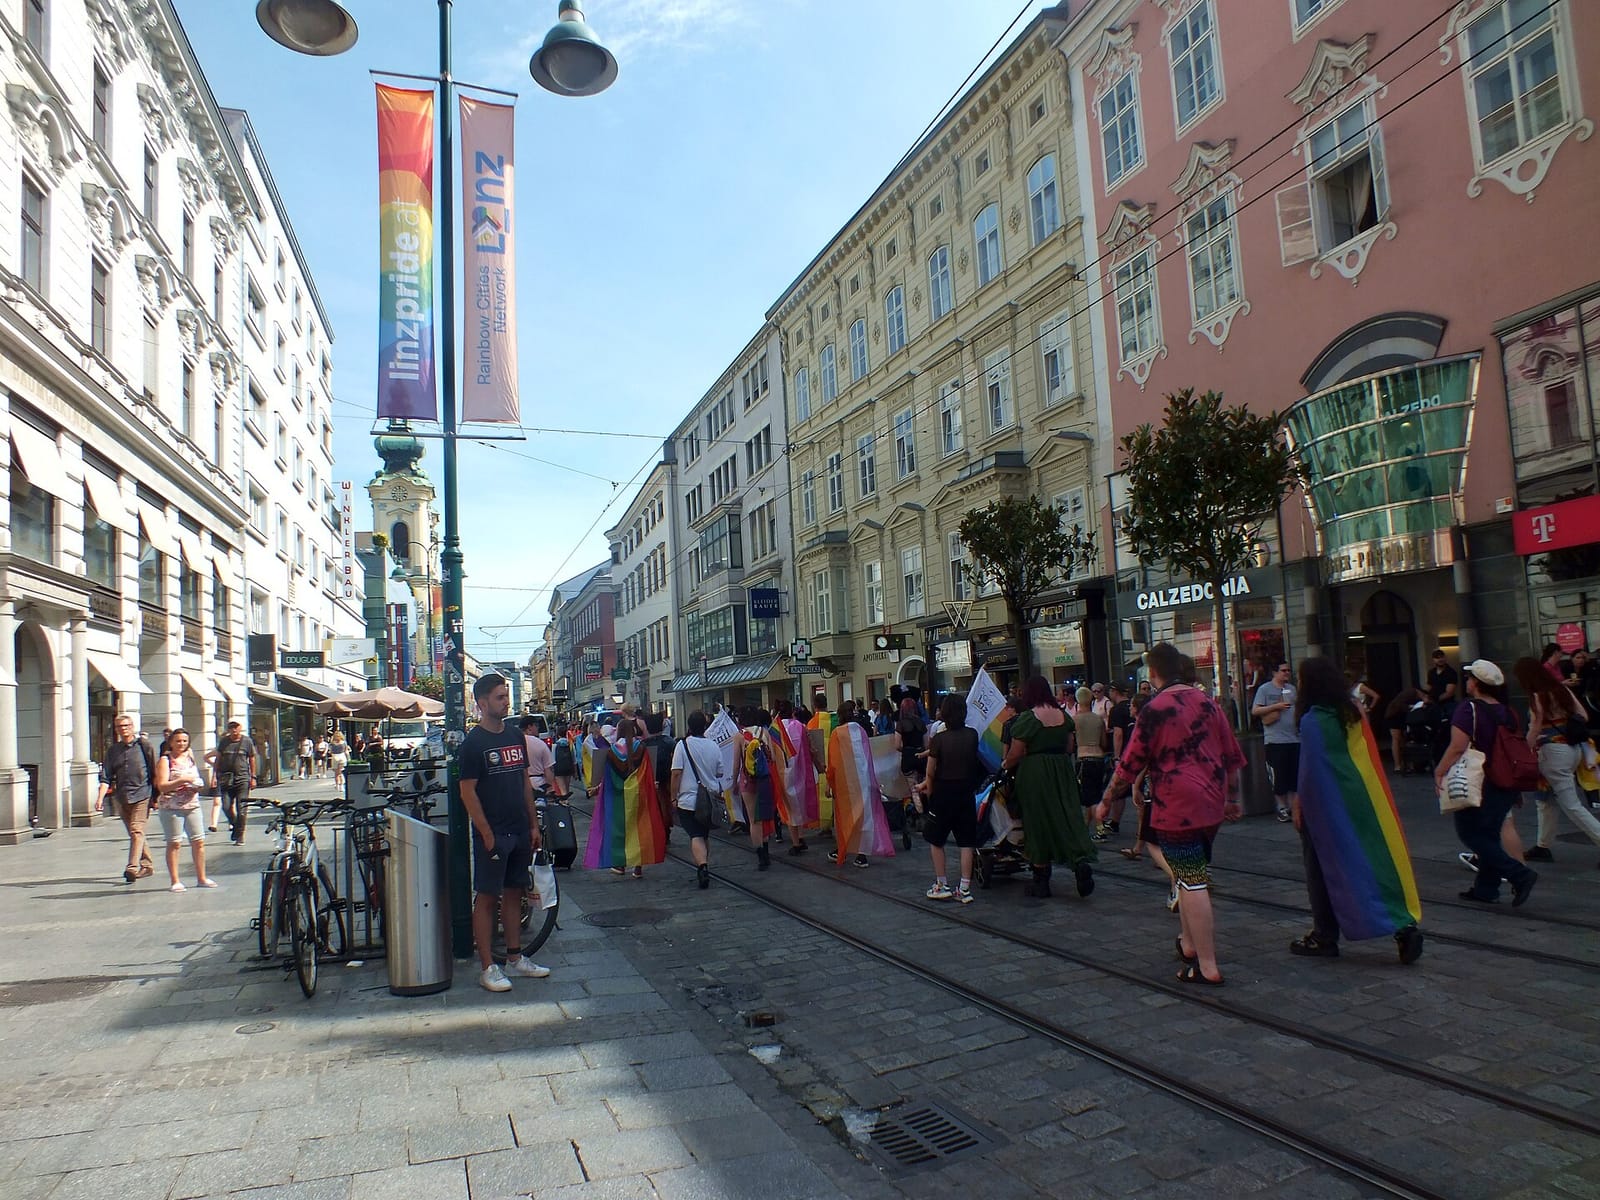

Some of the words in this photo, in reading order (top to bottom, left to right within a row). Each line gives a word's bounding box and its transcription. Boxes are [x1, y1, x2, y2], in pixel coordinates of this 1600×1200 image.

[389, 196, 425, 381] linzpride.at
[477, 265, 490, 312] Cities
[493, 266, 506, 334] Network
[477, 315, 491, 385] Rainbow
[341, 480, 352, 559] WINKLER
[1531, 513, 1556, 543] T
[344, 565, 353, 599] BAU
[285, 656, 319, 664] DOUGLAS
[503, 748, 524, 762] USA
